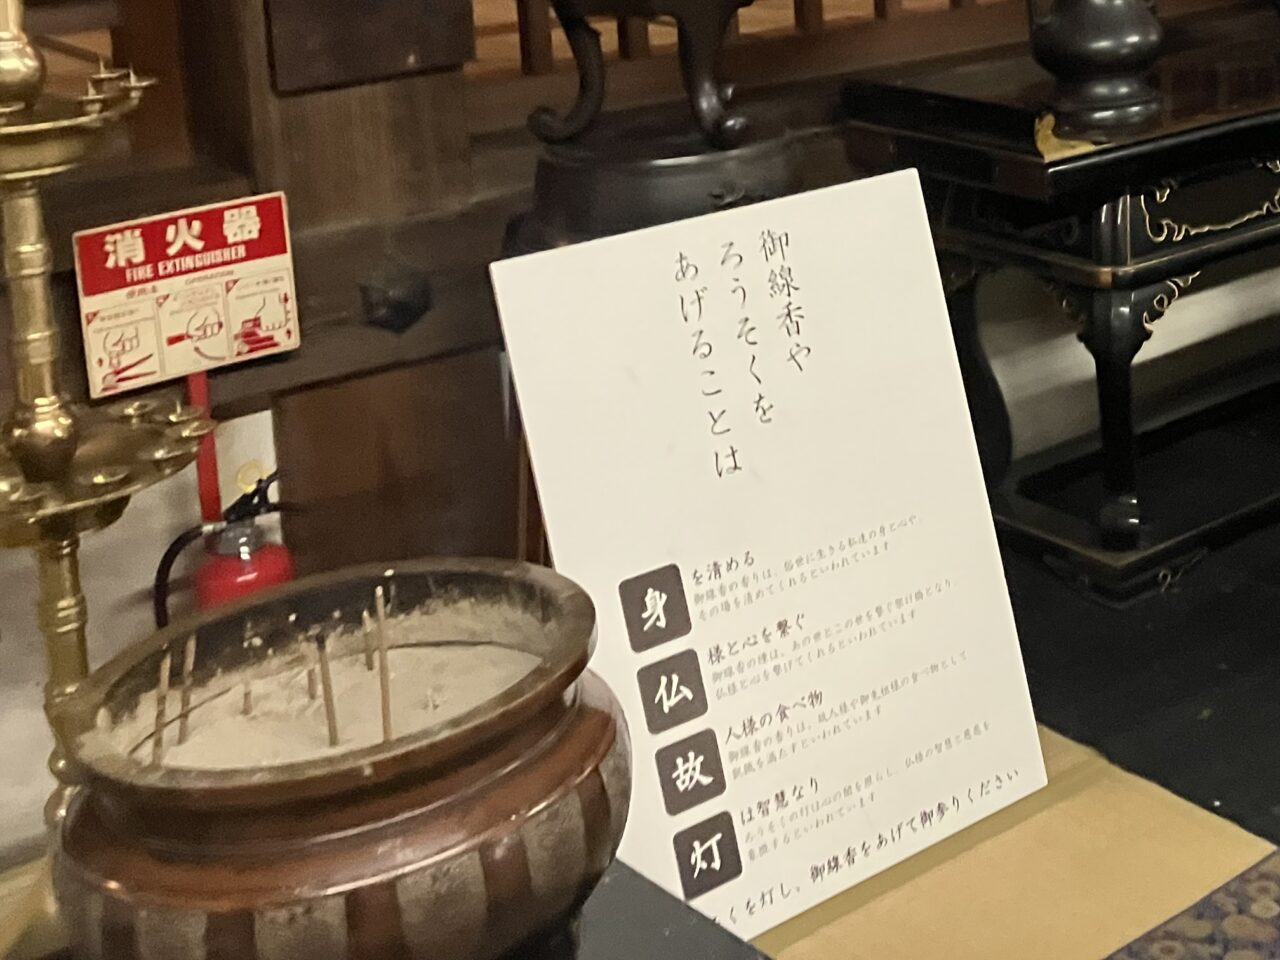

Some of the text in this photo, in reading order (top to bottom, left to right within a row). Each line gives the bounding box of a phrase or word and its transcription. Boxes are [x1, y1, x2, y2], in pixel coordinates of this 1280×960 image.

[103, 205, 262, 269] 消火器
[125, 244, 247, 283] FIRE EXTINGUISHER
[721, 242, 773, 423] ろうそくを
[762, 230, 811, 371] 御線香や
[676, 252, 742, 477] あげることは
[641, 551, 754, 631] 身 を清める
[654, 614, 804, 713] 仏 様と心を繋ぐ
[672, 690, 822, 792] 故 人様の食べ物
[689, 777, 817, 878] 灯 は智慧なり
[709, 769, 1019, 924] くを灯し、御線香をあげて御参りください
